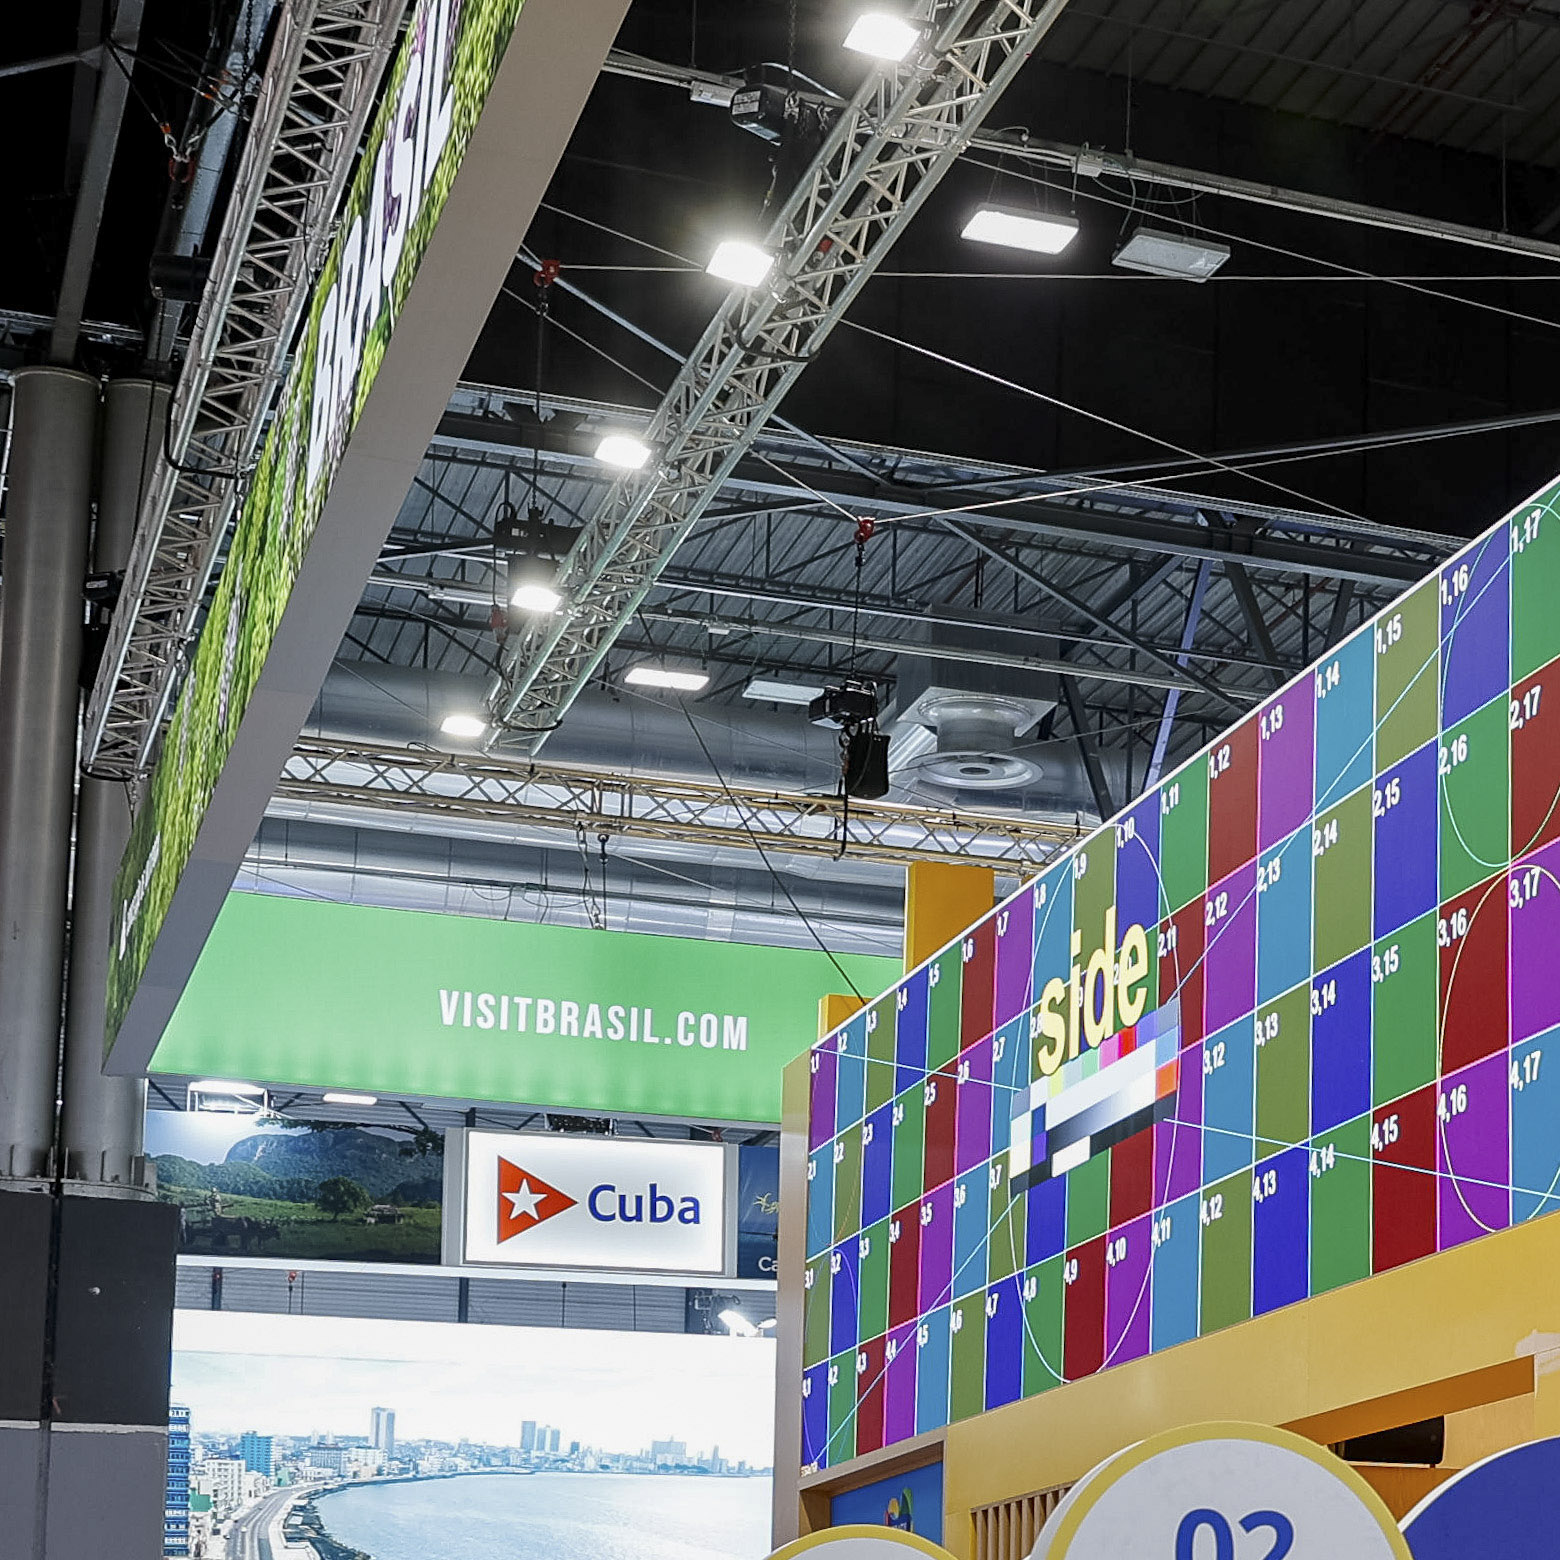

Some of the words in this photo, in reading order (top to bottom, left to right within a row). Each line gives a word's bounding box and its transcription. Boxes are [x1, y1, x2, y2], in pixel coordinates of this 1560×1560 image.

[1511, 509, 1542, 553] 1,17
[1441, 563, 1469, 605] 1,16
[1376, 613, 1402, 654] 1,15
[1315, 660, 1340, 699] 1,14
[1260, 704, 1284, 740] 1,13
[1510, 684, 1542, 730] 2,17
[1209, 744, 1231, 778] 1,12
[1439, 734, 1468, 776] 2,16
[1373, 778, 1400, 817] 2,15
[1313, 819, 1338, 857] 2,14
[1257, 858, 1281, 893] 2,13
[1510, 866, 1541, 909] 3,17
[1205, 891, 1228, 925] 2,12
[1438, 907, 1467, 947] 3,16
[1372, 945, 1399, 983] 3,15
[1038, 905, 1148, 1075] side
[1311, 980, 1336, 1015] 3,14
[438, 989, 748, 1051] VISITBRASIL.COM
[1255, 1012, 1279, 1046] 3,13
[1203, 1042, 1225, 1075] 3,12
[1510, 1050, 1541, 1091] 4,17
[1437, 1084, 1467, 1123] 4,16
[1371, 1115, 1399, 1151] 4,15
[1309, 1143, 1335, 1177] 4,14
[587, 1182, 701, 1225] Cuba
[1252, 1170, 1277, 1203] 4,13
[1200, 1194, 1223, 1226] 4,12
